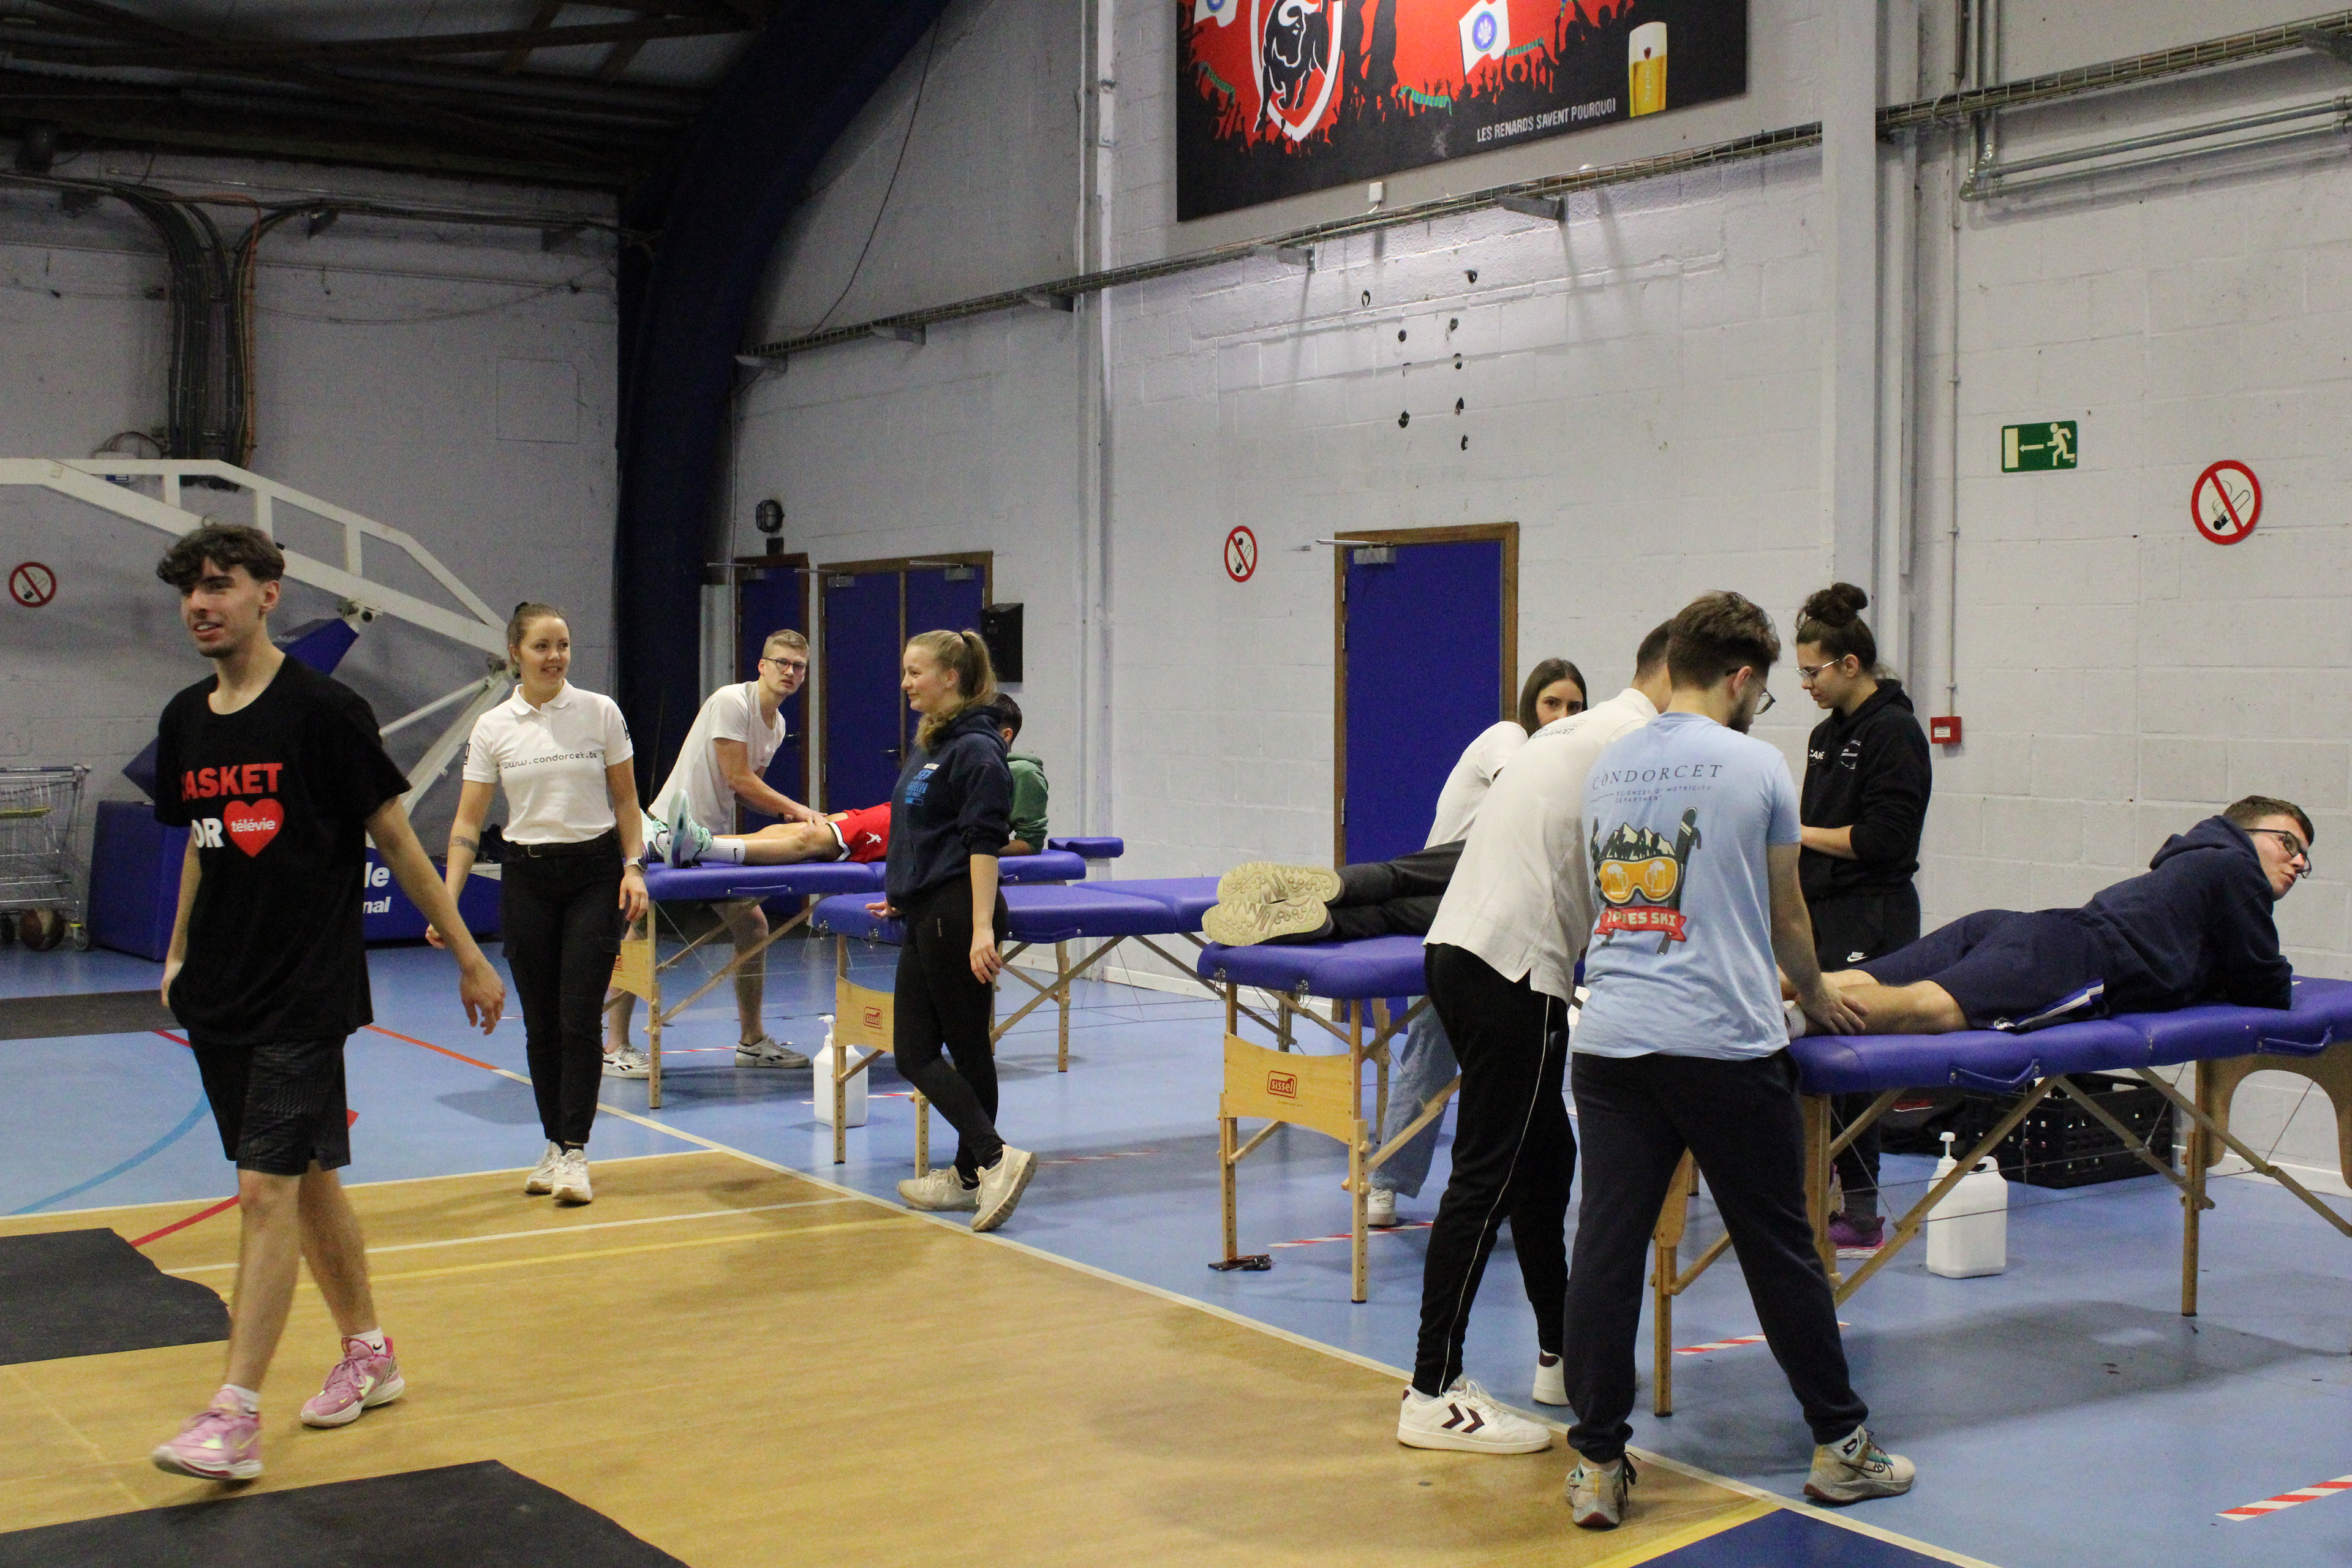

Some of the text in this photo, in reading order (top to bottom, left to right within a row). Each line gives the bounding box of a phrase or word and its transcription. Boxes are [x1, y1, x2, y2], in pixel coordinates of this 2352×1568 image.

[1477, 97, 1616, 143] LES RENARDS SAVENT POURQUOI
[182, 763, 283, 801] ASKET
[1593, 764, 1723, 790] CONDORCET
[192, 817, 276, 848] OR télévie
[364, 862, 391, 888] le
[363, 896, 391, 914] nal
[1651, 912, 1676, 927] SKI
[865, 1014, 881, 1025] sissel
[1270, 1080, 1294, 1093] sissel
